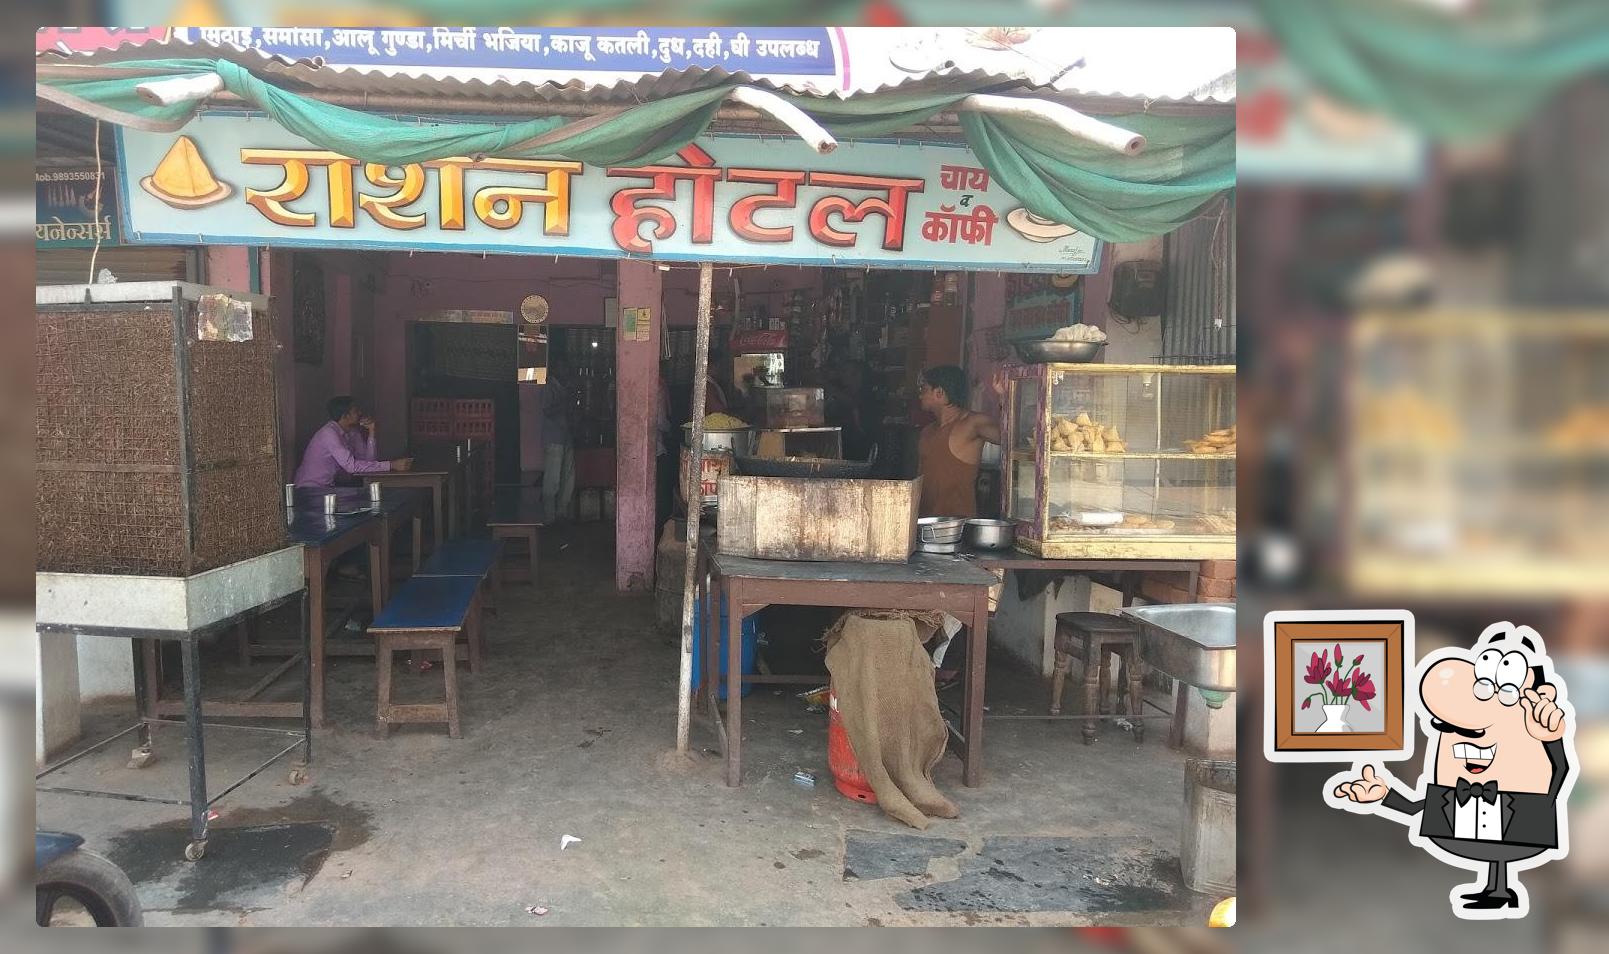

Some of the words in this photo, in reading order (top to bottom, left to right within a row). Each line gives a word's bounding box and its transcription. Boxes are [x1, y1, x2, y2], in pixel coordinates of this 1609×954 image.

[606, 143, 925, 254] होटल
[940, 164, 990, 192] चाय
[921, 202, 999, 246] कॉफी
